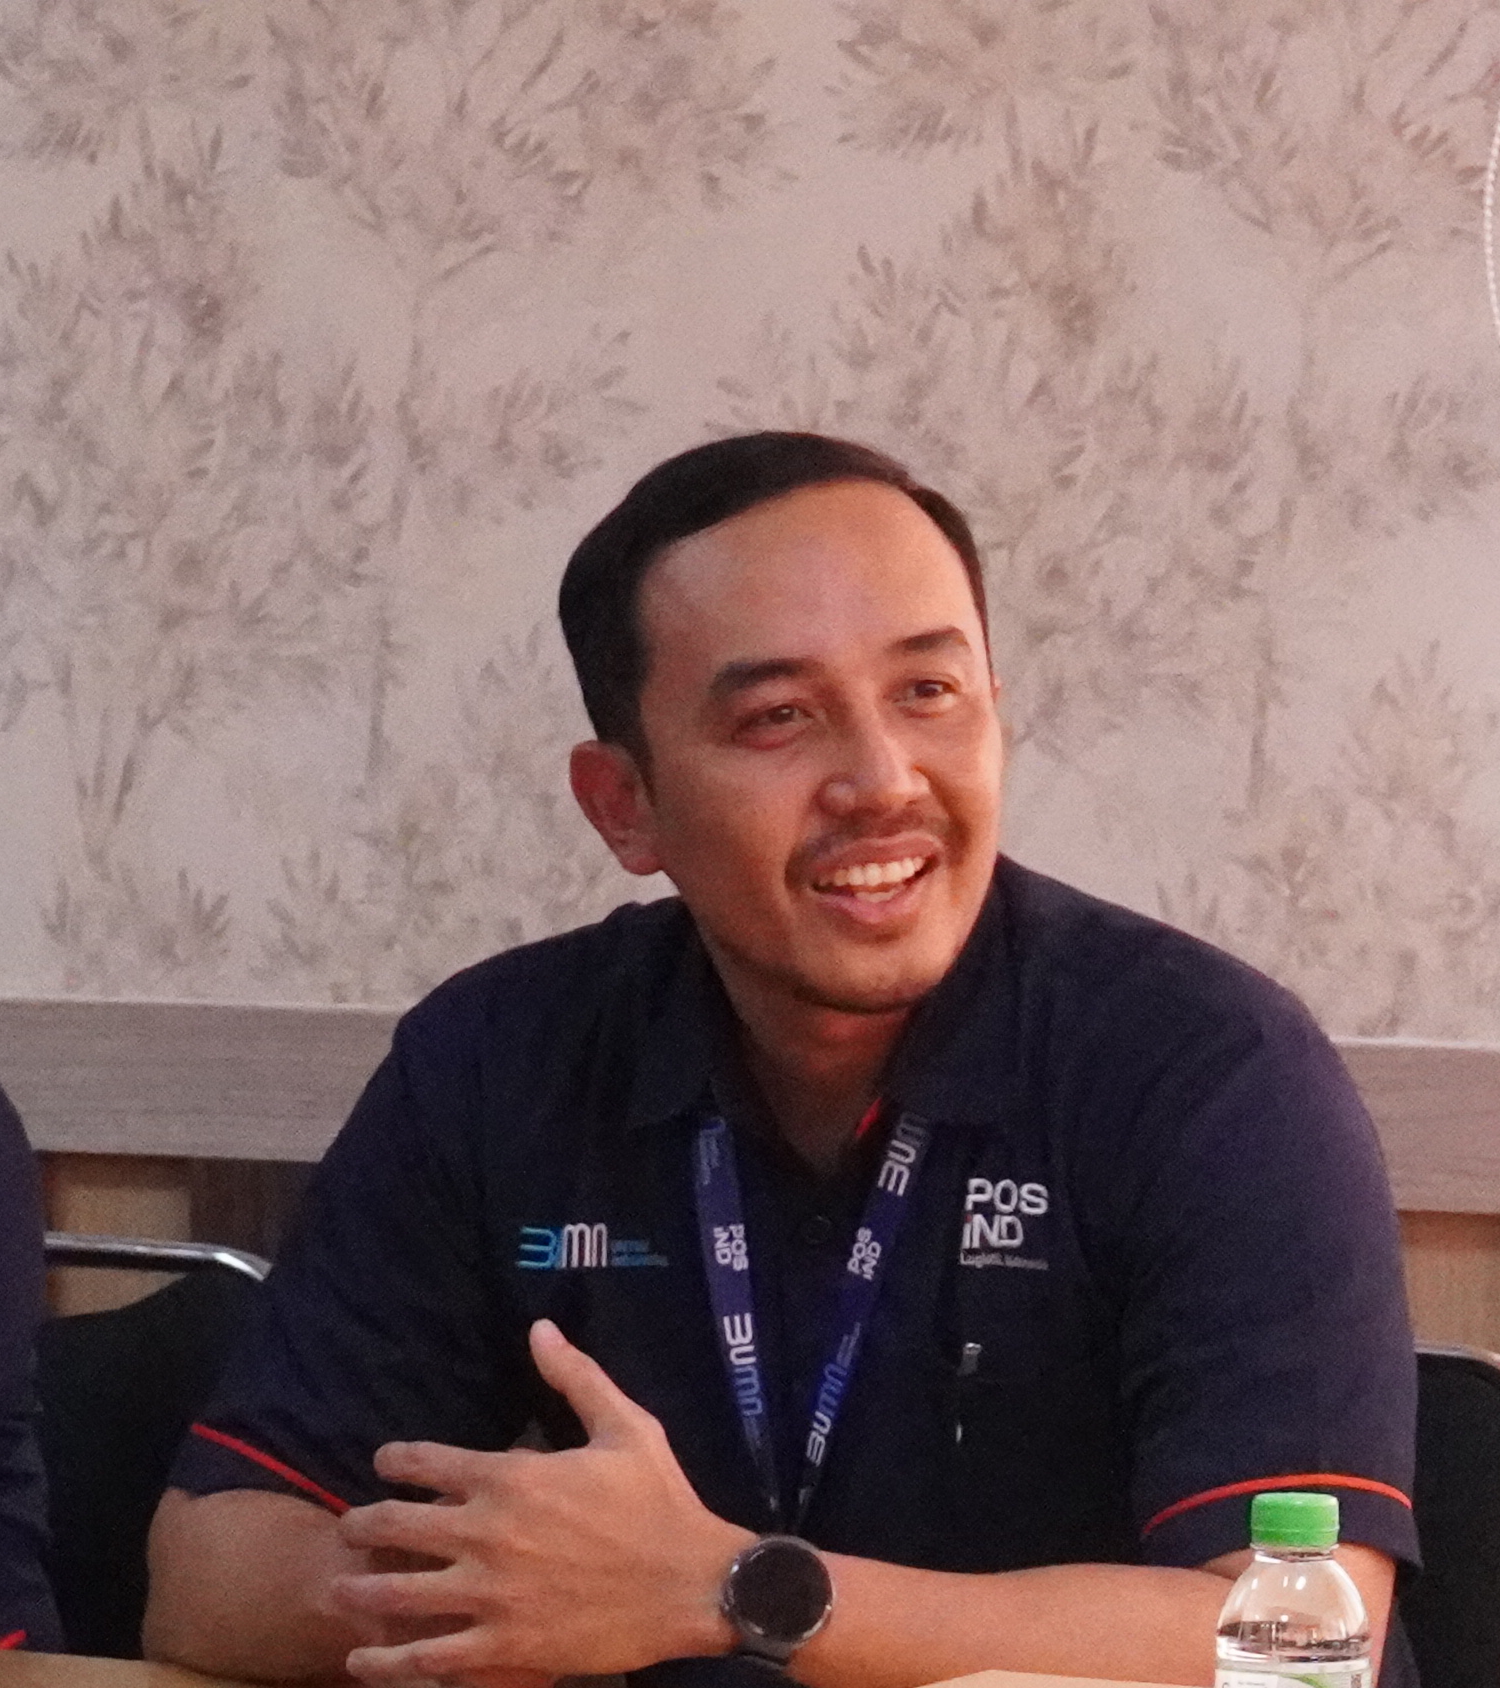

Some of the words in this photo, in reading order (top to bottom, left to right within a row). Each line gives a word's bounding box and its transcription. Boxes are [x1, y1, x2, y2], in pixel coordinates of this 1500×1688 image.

[964, 1177, 1050, 1216] POS
[729, 1222, 750, 1271] POS
[846, 1225, 873, 1275] POS
